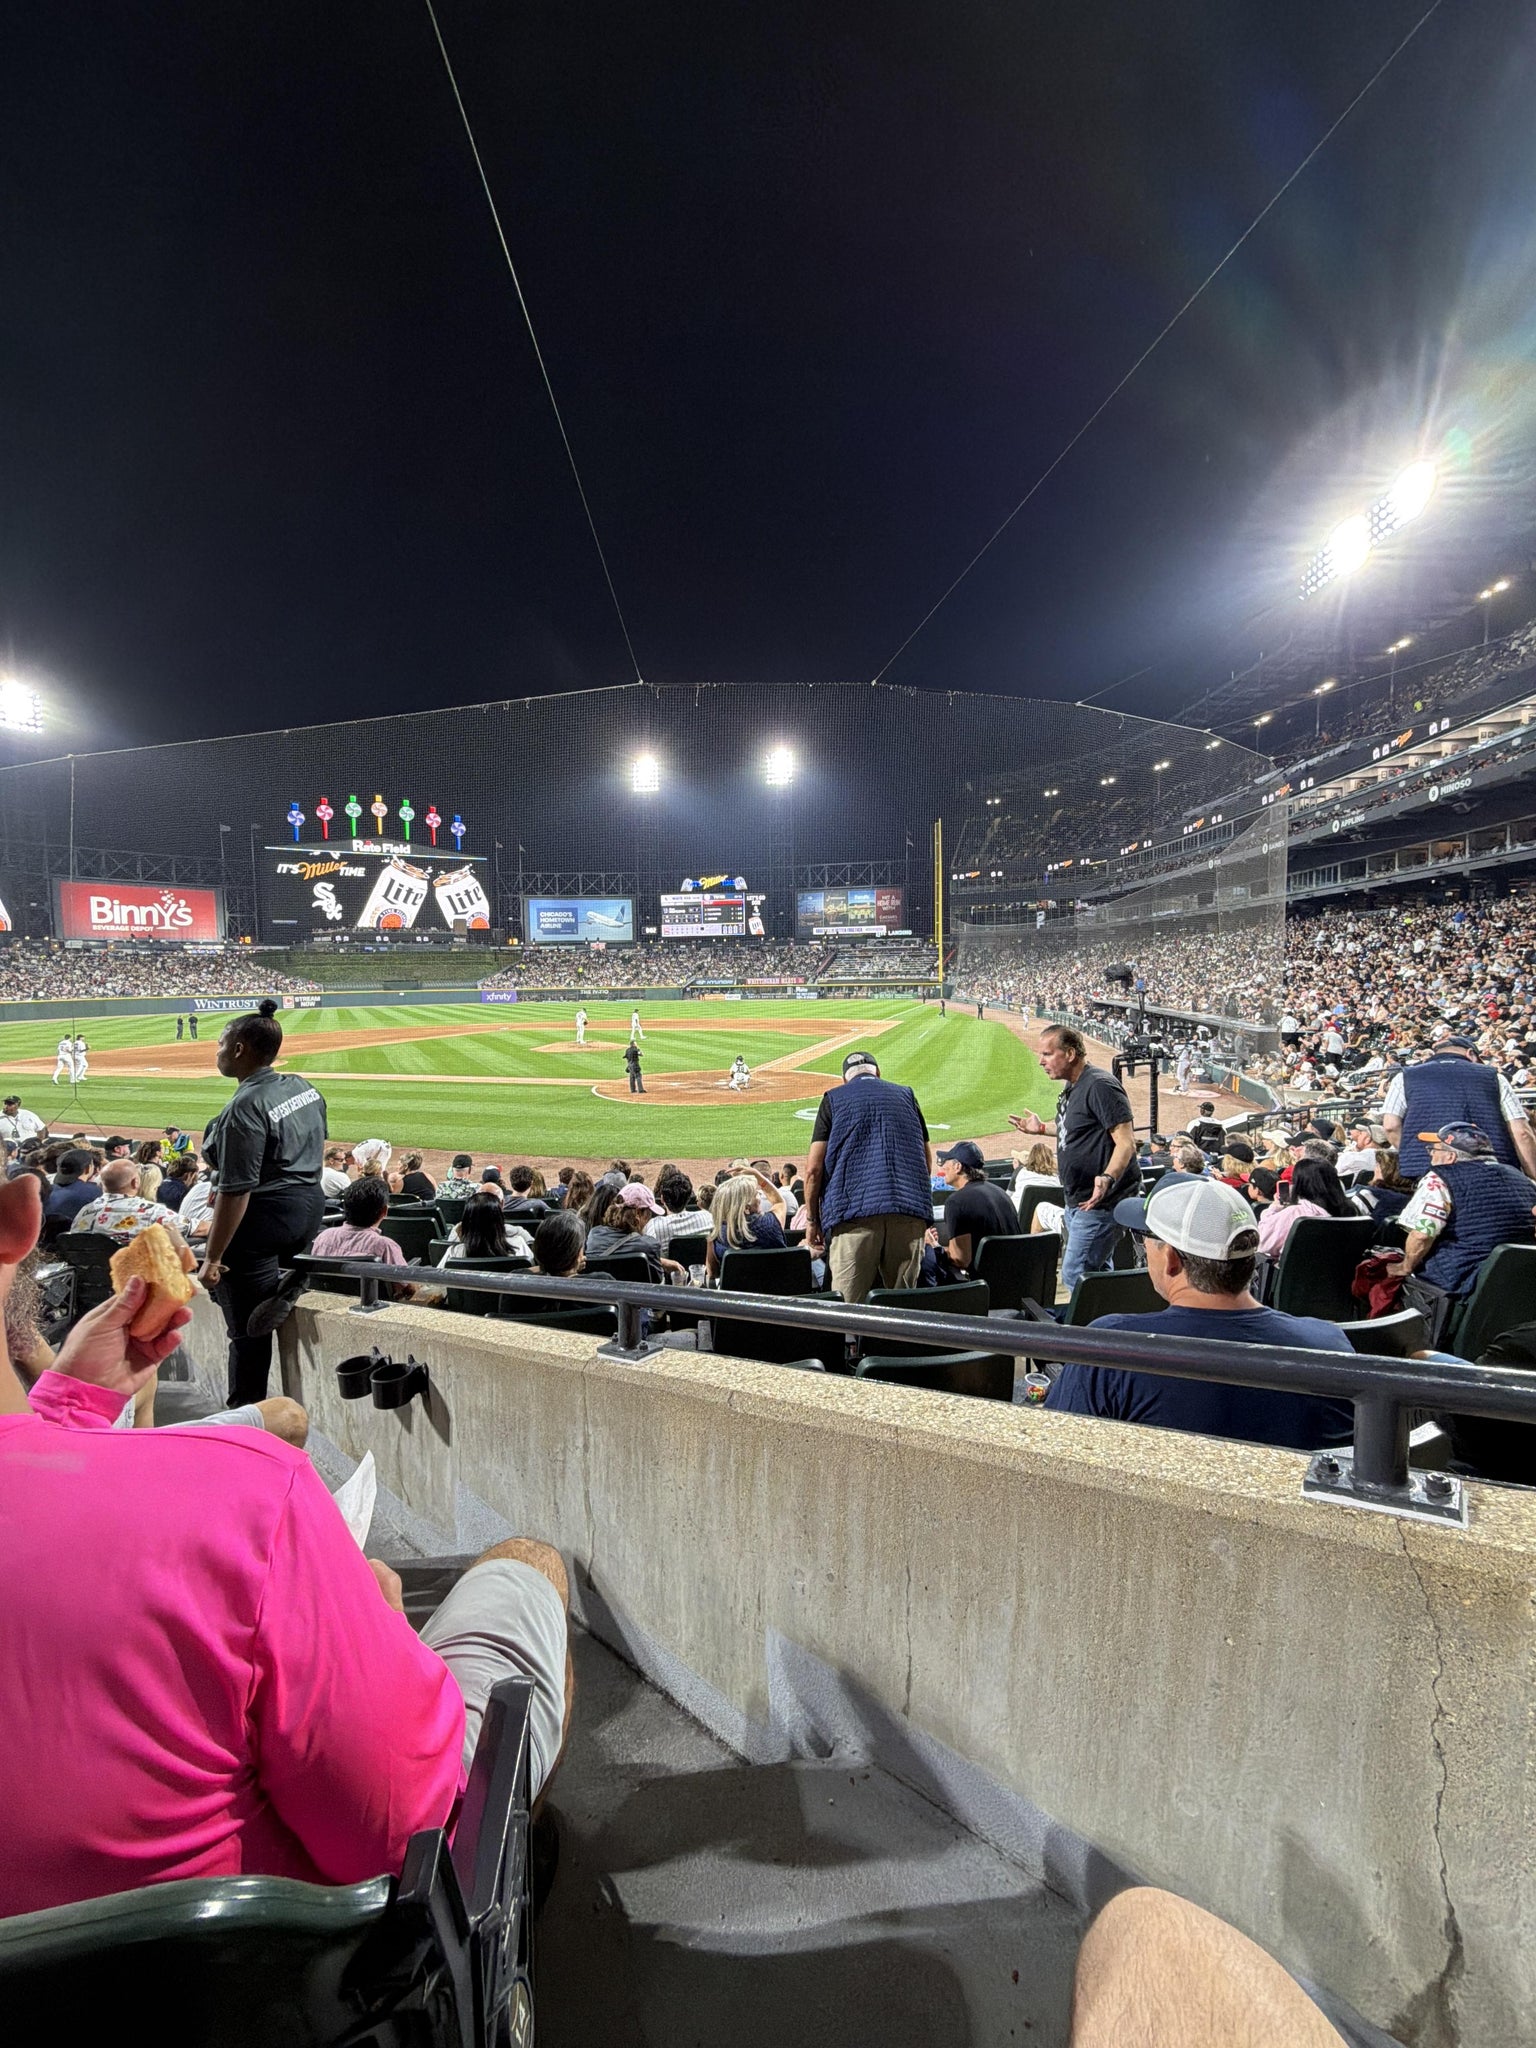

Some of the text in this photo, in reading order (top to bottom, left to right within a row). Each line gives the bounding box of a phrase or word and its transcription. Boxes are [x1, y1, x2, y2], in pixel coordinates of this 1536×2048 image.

[1440, 778, 1472, 795] MINOSO
[352, 840, 411, 854] Rate Field
[277, 861, 366, 881] IT'S Miller TIME
[382, 877, 424, 906] Lite
[445, 885, 482, 915] Lite
[92, 924, 130, 932] BEVERAGE
[194, 999, 259, 1009] WINTRUST
[486, 991, 512, 1002] xfinity
[268, 1088, 321, 1123] GUEST SERVICES
